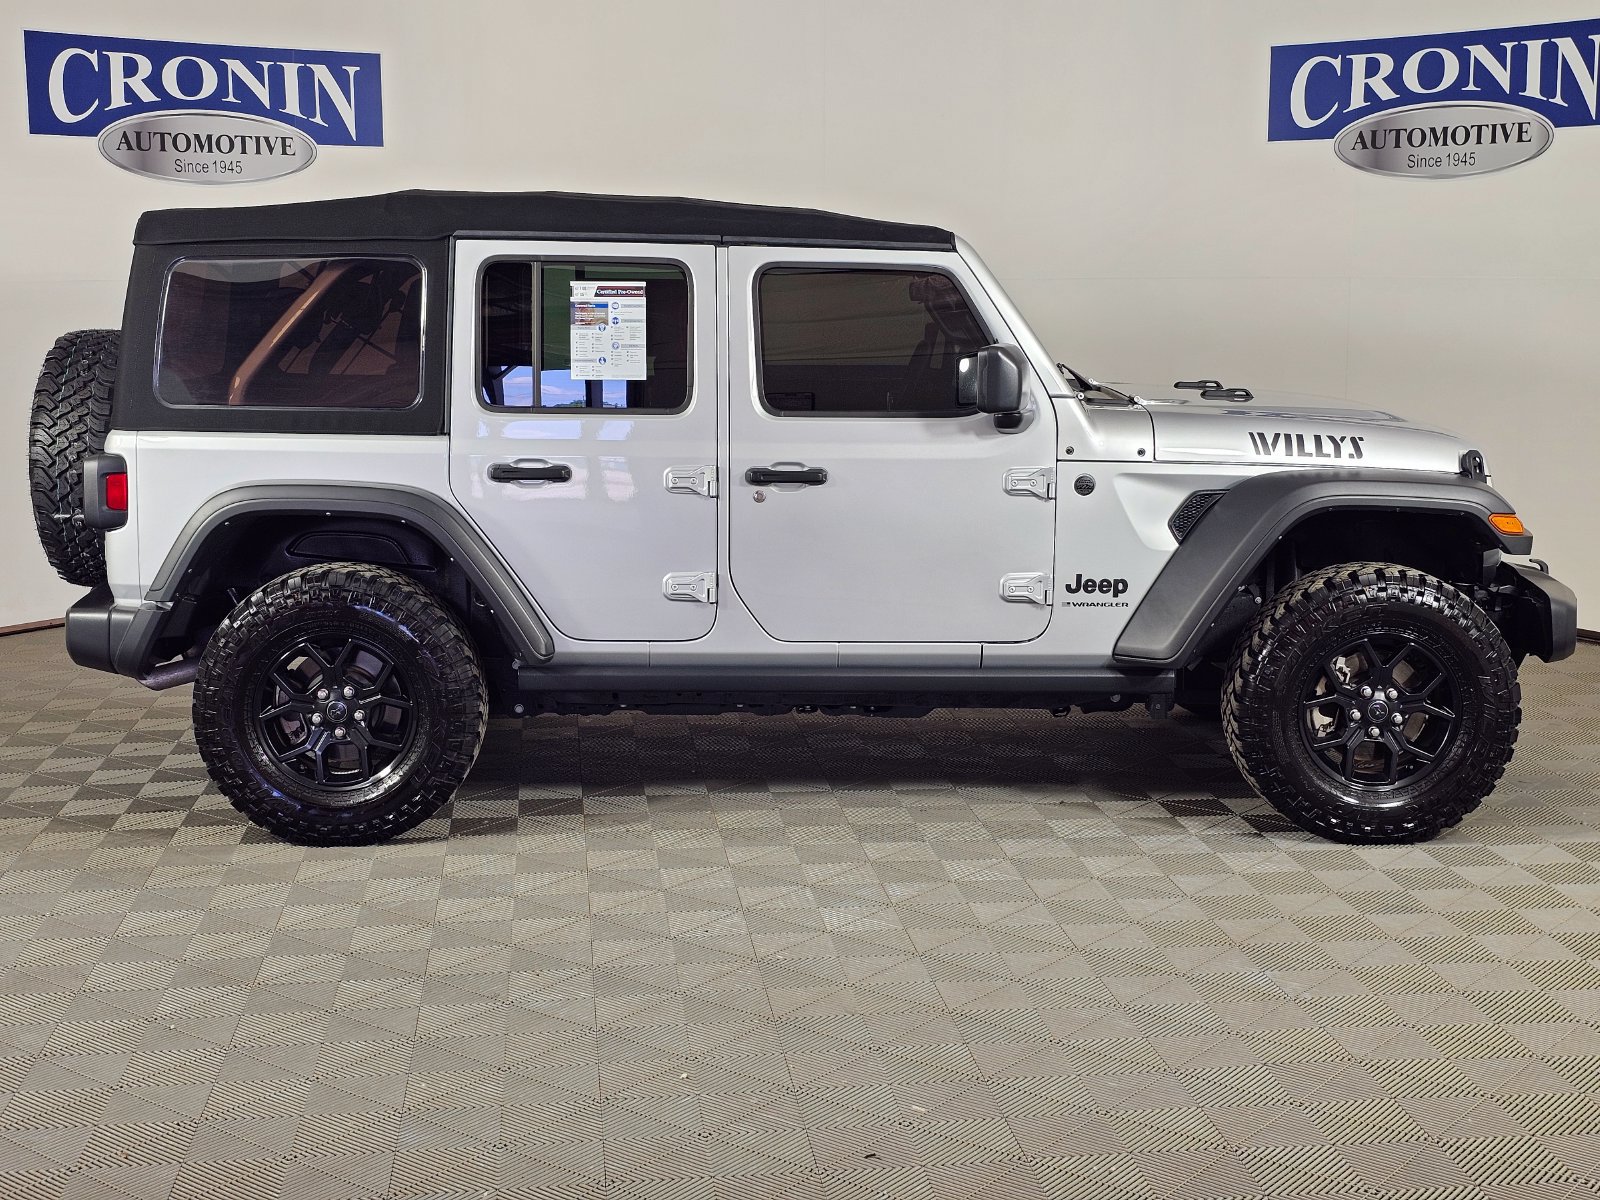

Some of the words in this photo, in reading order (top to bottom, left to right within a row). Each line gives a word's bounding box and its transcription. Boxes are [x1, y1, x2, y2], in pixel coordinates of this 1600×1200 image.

[48, 47, 360, 141] CRONIN
[1290, 34, 1600, 128] CRONIN
[116, 130, 296, 157] AUTOMOTIVE
[1350, 121, 1532, 151] AUTOMOTIVE
[174, 158, 209, 174] Since
[212, 160, 243, 175] 1945
[1407, 153, 1442, 169] Since
[1446, 152, 1476, 167] 1945
[1248, 431, 1365, 459] WILLYS
[1065, 573, 1128, 598] Jeep
